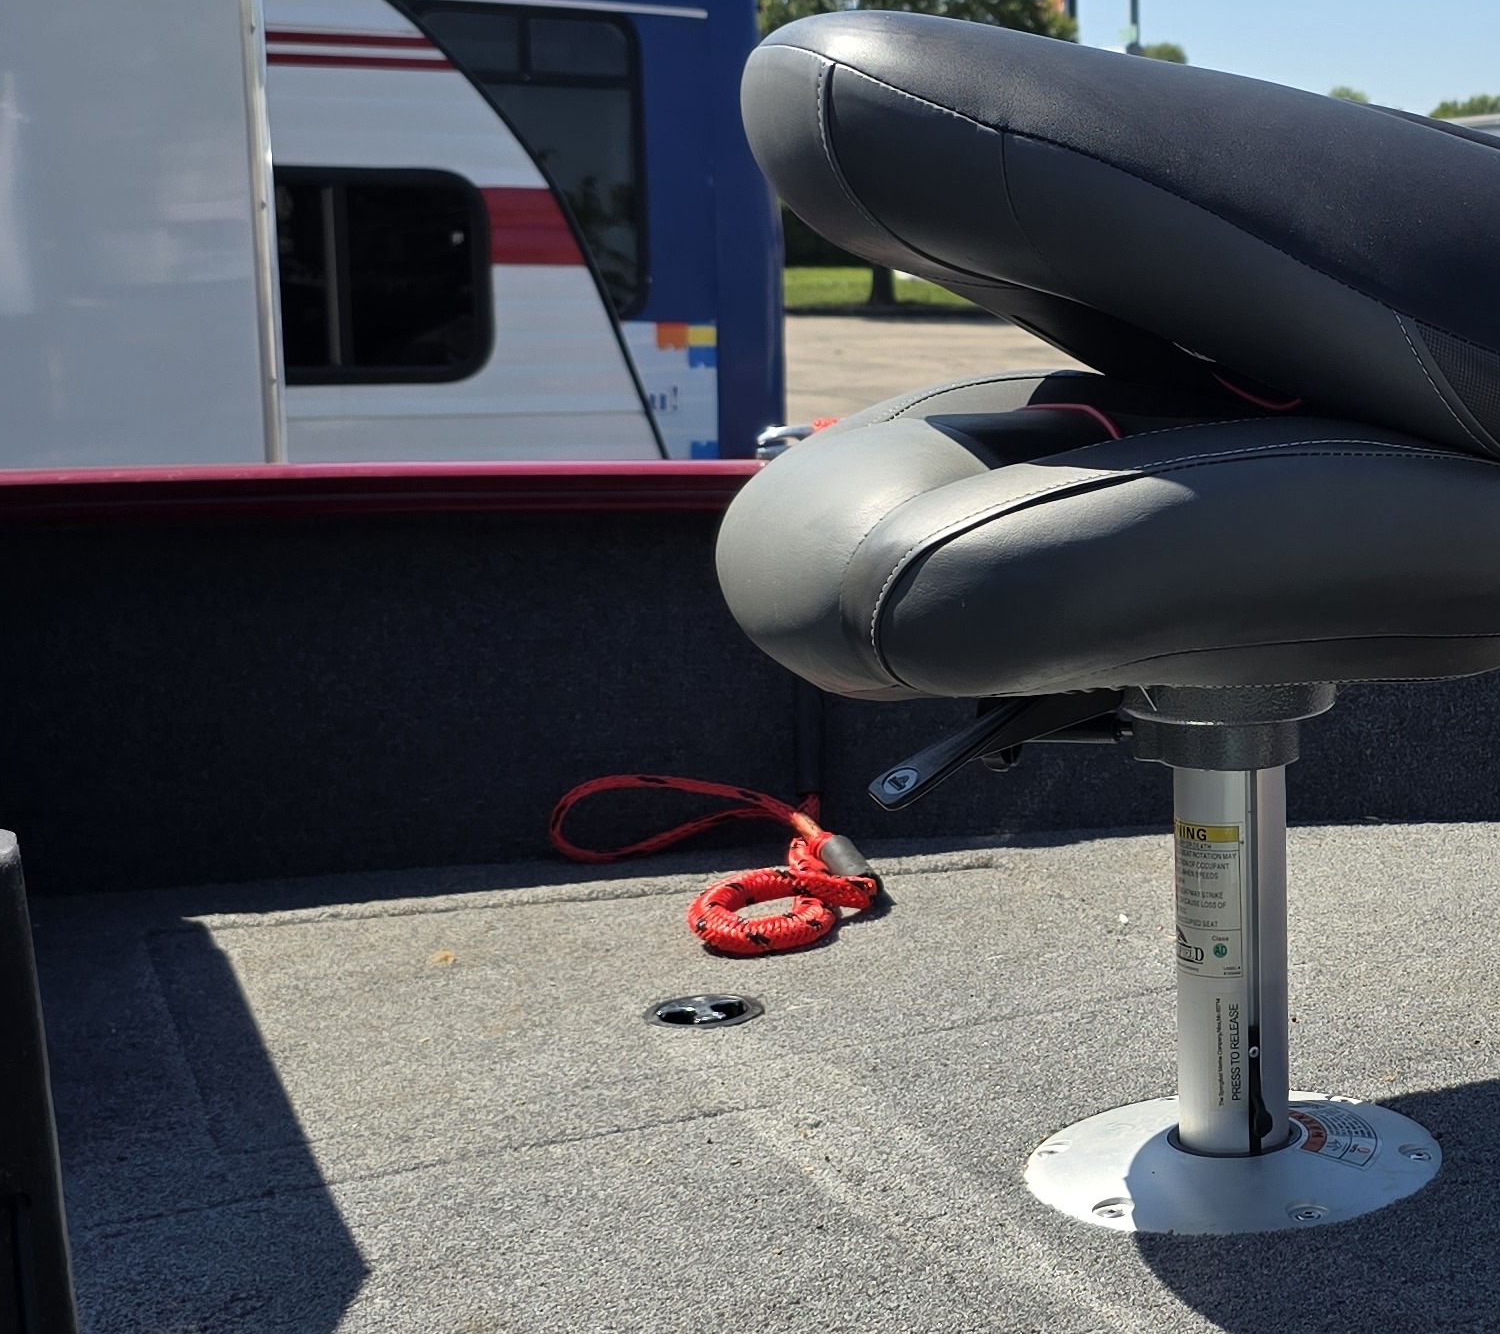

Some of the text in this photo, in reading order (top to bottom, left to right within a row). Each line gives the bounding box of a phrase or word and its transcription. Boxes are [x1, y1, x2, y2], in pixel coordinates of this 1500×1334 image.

[1222, 852, 1237, 860] MAY
[1196, 861, 1230, 870] OCCUPANT
[1201, 891, 1224, 900] STRIKE
[1201, 900, 1217, 909] LOSS
[1217, 901, 1227, 909] OF
[1202, 920, 1219, 928] SEAT
[1229, 1004, 1241, 1100] PRESS TO RELEASE
